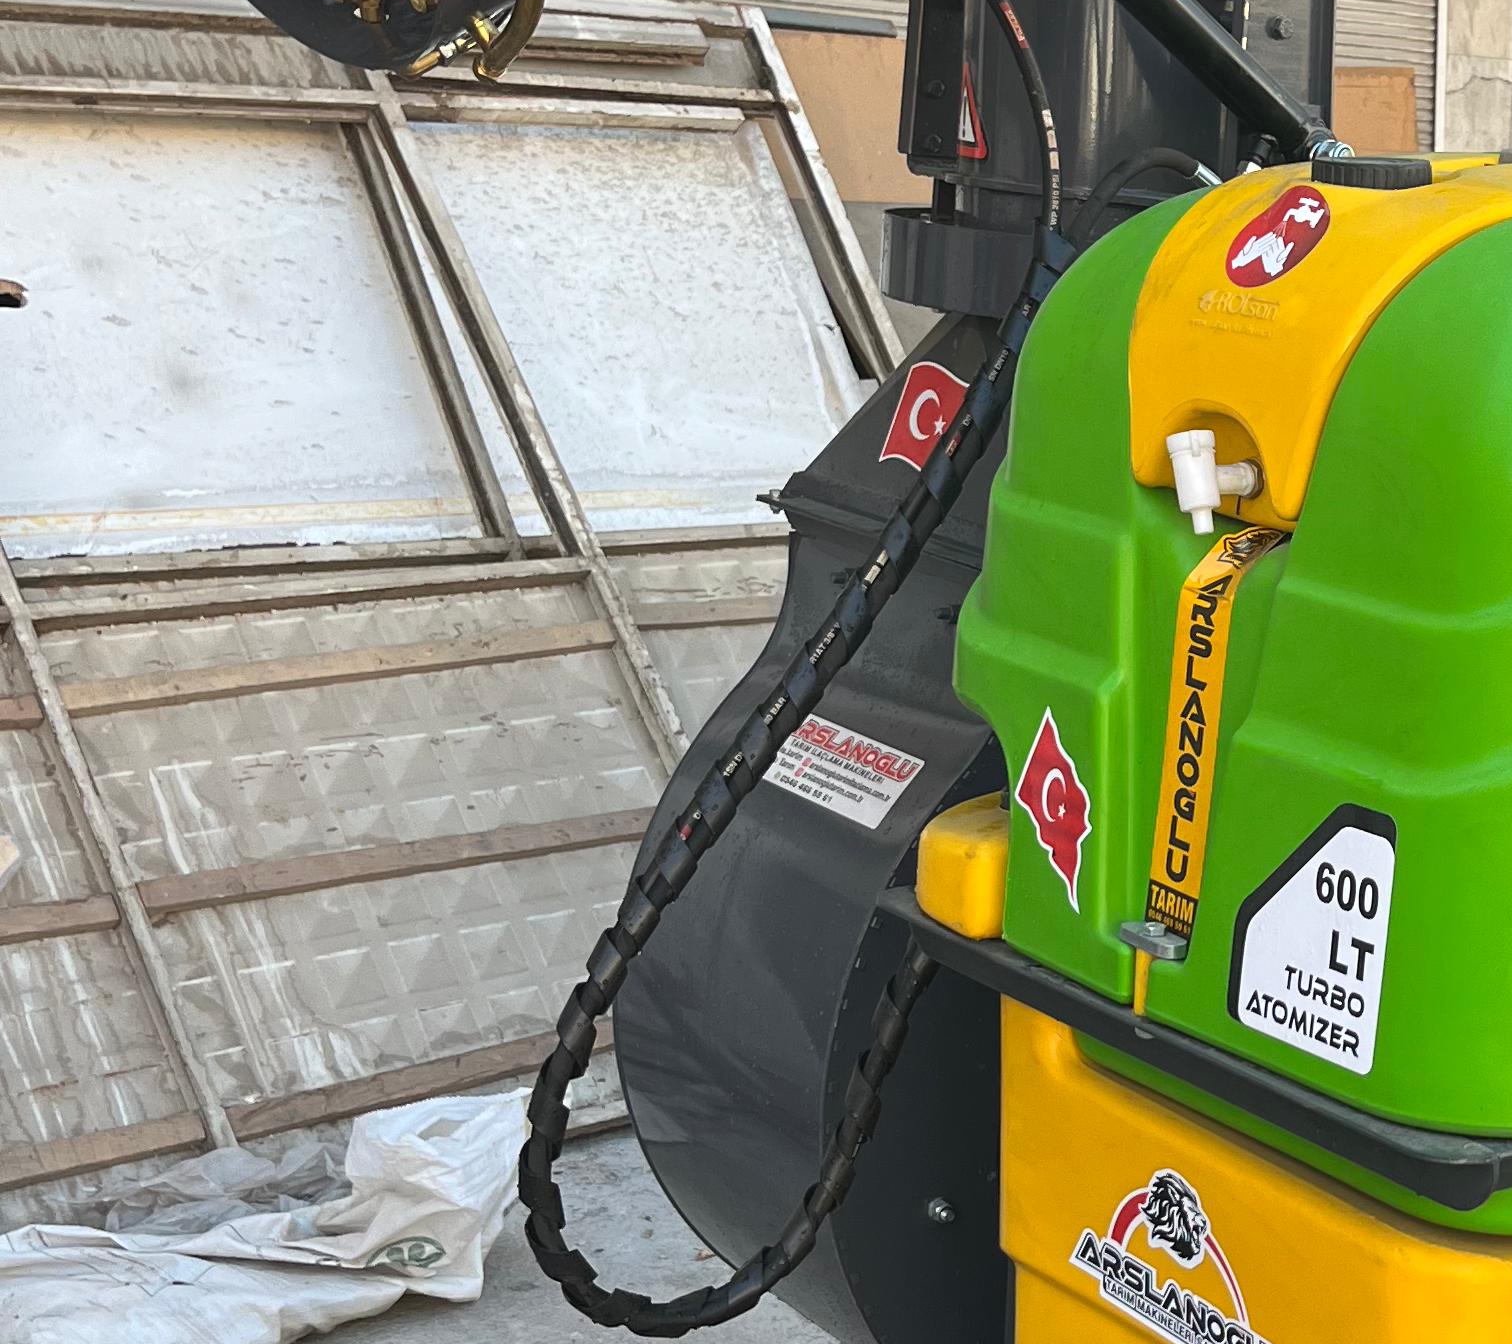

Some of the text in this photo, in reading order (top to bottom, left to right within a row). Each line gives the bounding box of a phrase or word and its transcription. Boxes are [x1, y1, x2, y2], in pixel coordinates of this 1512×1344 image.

[1165, 572, 1234, 884] ARSLANOGLU
[1151, 884, 1194, 924] TARIM
[1315, 860, 1380, 921] 600
[1328, 928, 1376, 983] LT
[1284, 963, 1366, 1019] TURBO
[1245, 988, 1361, 1059] ATOMIZER
[1105, 1277, 1136, 1306] TARIM
